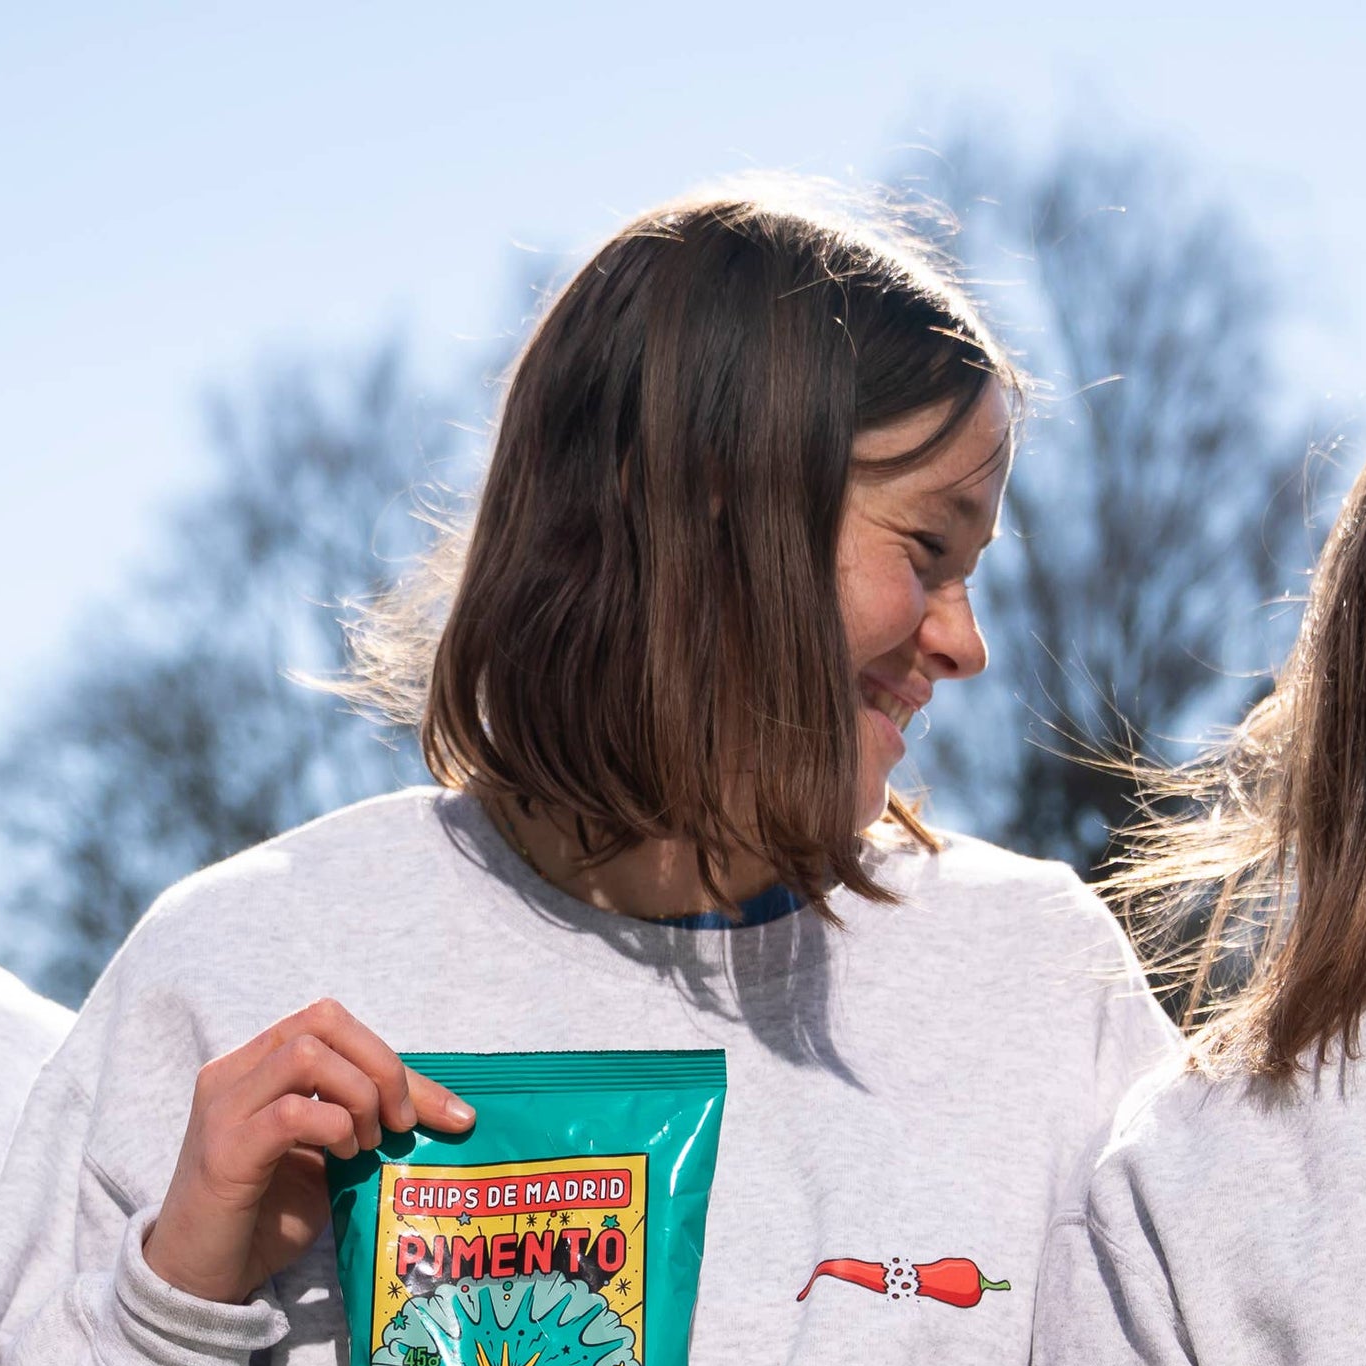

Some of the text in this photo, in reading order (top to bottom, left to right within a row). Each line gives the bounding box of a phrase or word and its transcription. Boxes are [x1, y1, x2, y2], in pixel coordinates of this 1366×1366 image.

[400, 1177, 625, 1210] CHIPS DE MADRID
[395, 1227, 628, 1280] PIMENTO
